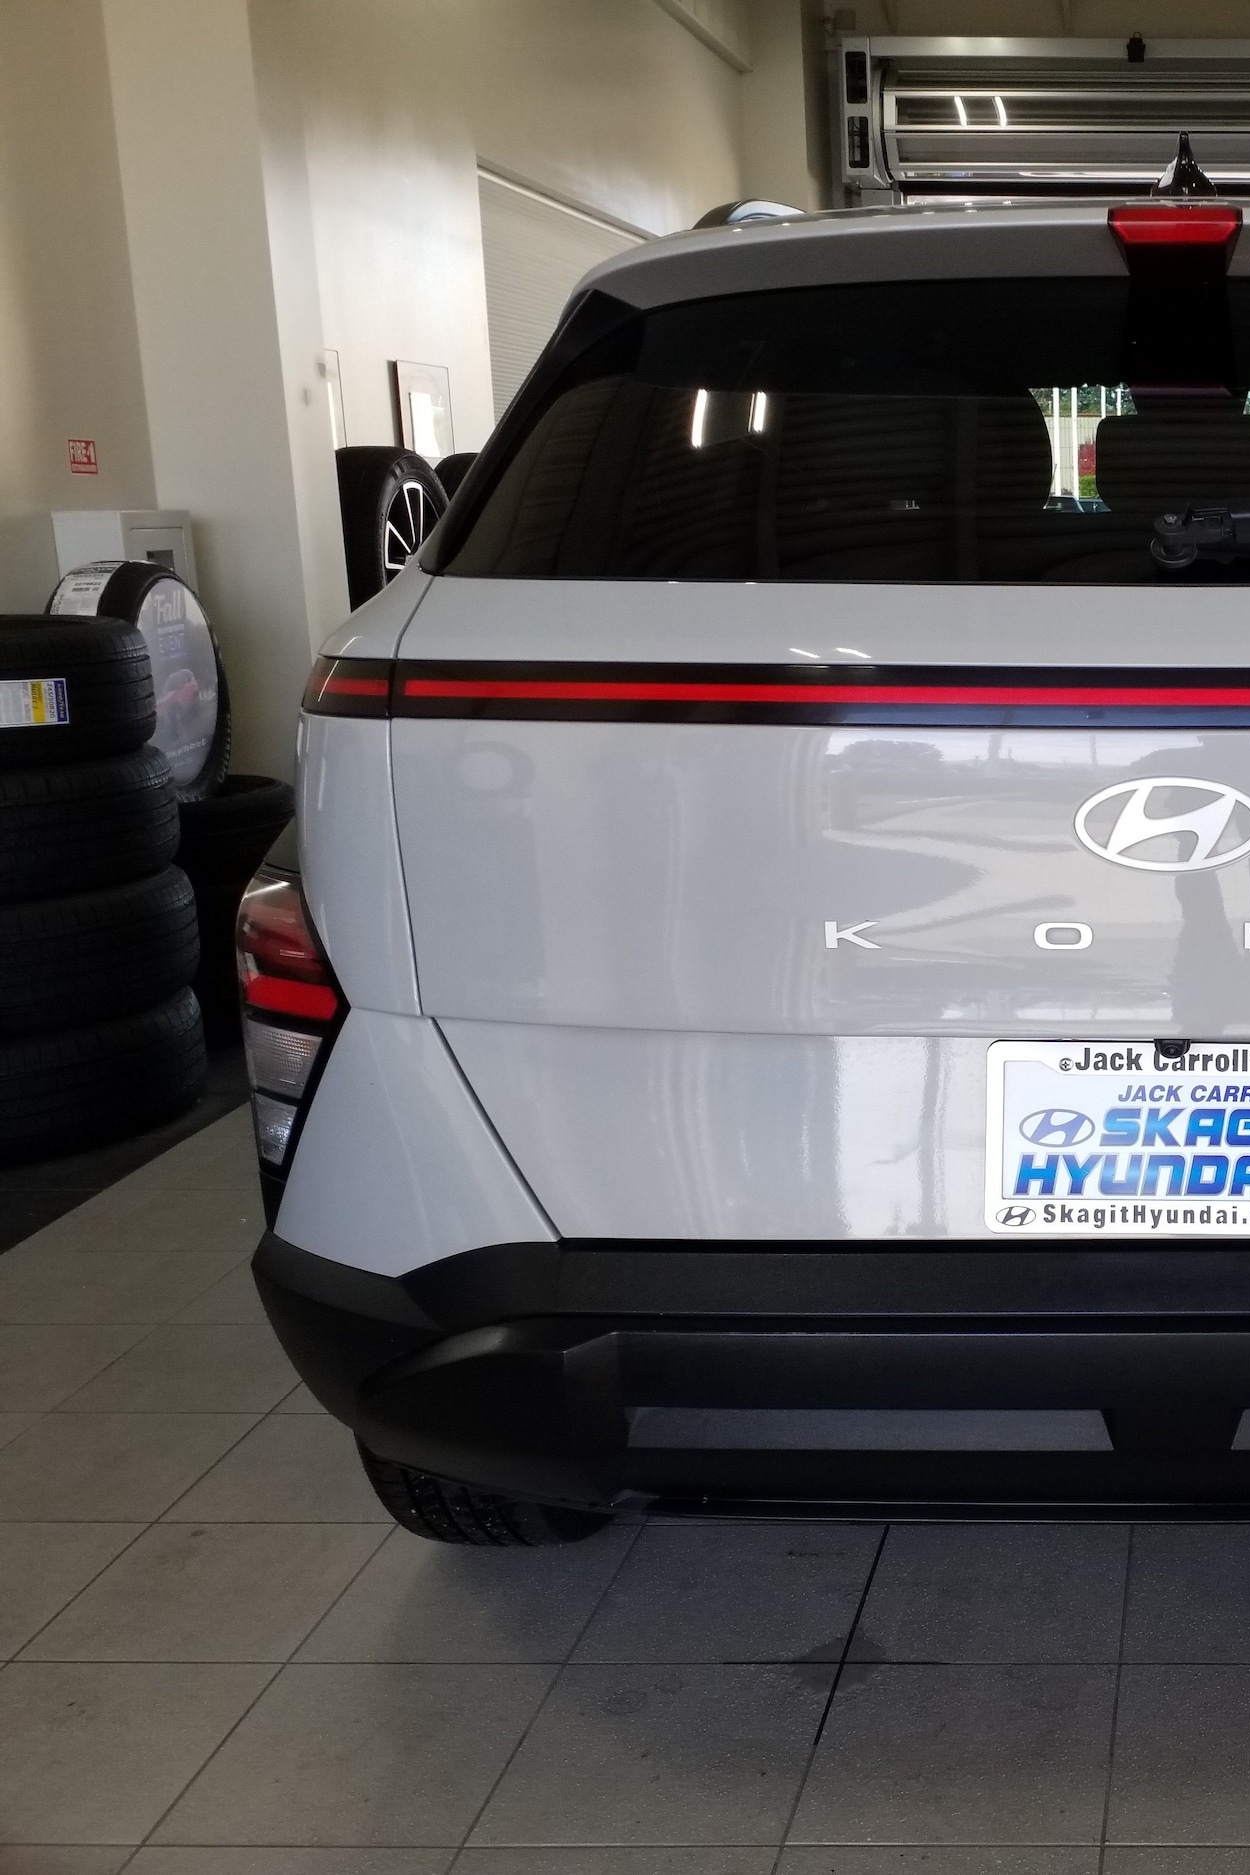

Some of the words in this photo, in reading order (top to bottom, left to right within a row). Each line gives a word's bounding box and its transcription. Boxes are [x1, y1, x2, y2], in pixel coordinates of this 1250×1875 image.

[70, 441, 89, 462] FIRE
[153, 589, 183, 625] Fall
[1075, 1047, 1143, 1072] Jack
[1118, 1084, 1184, 1102] JACK
